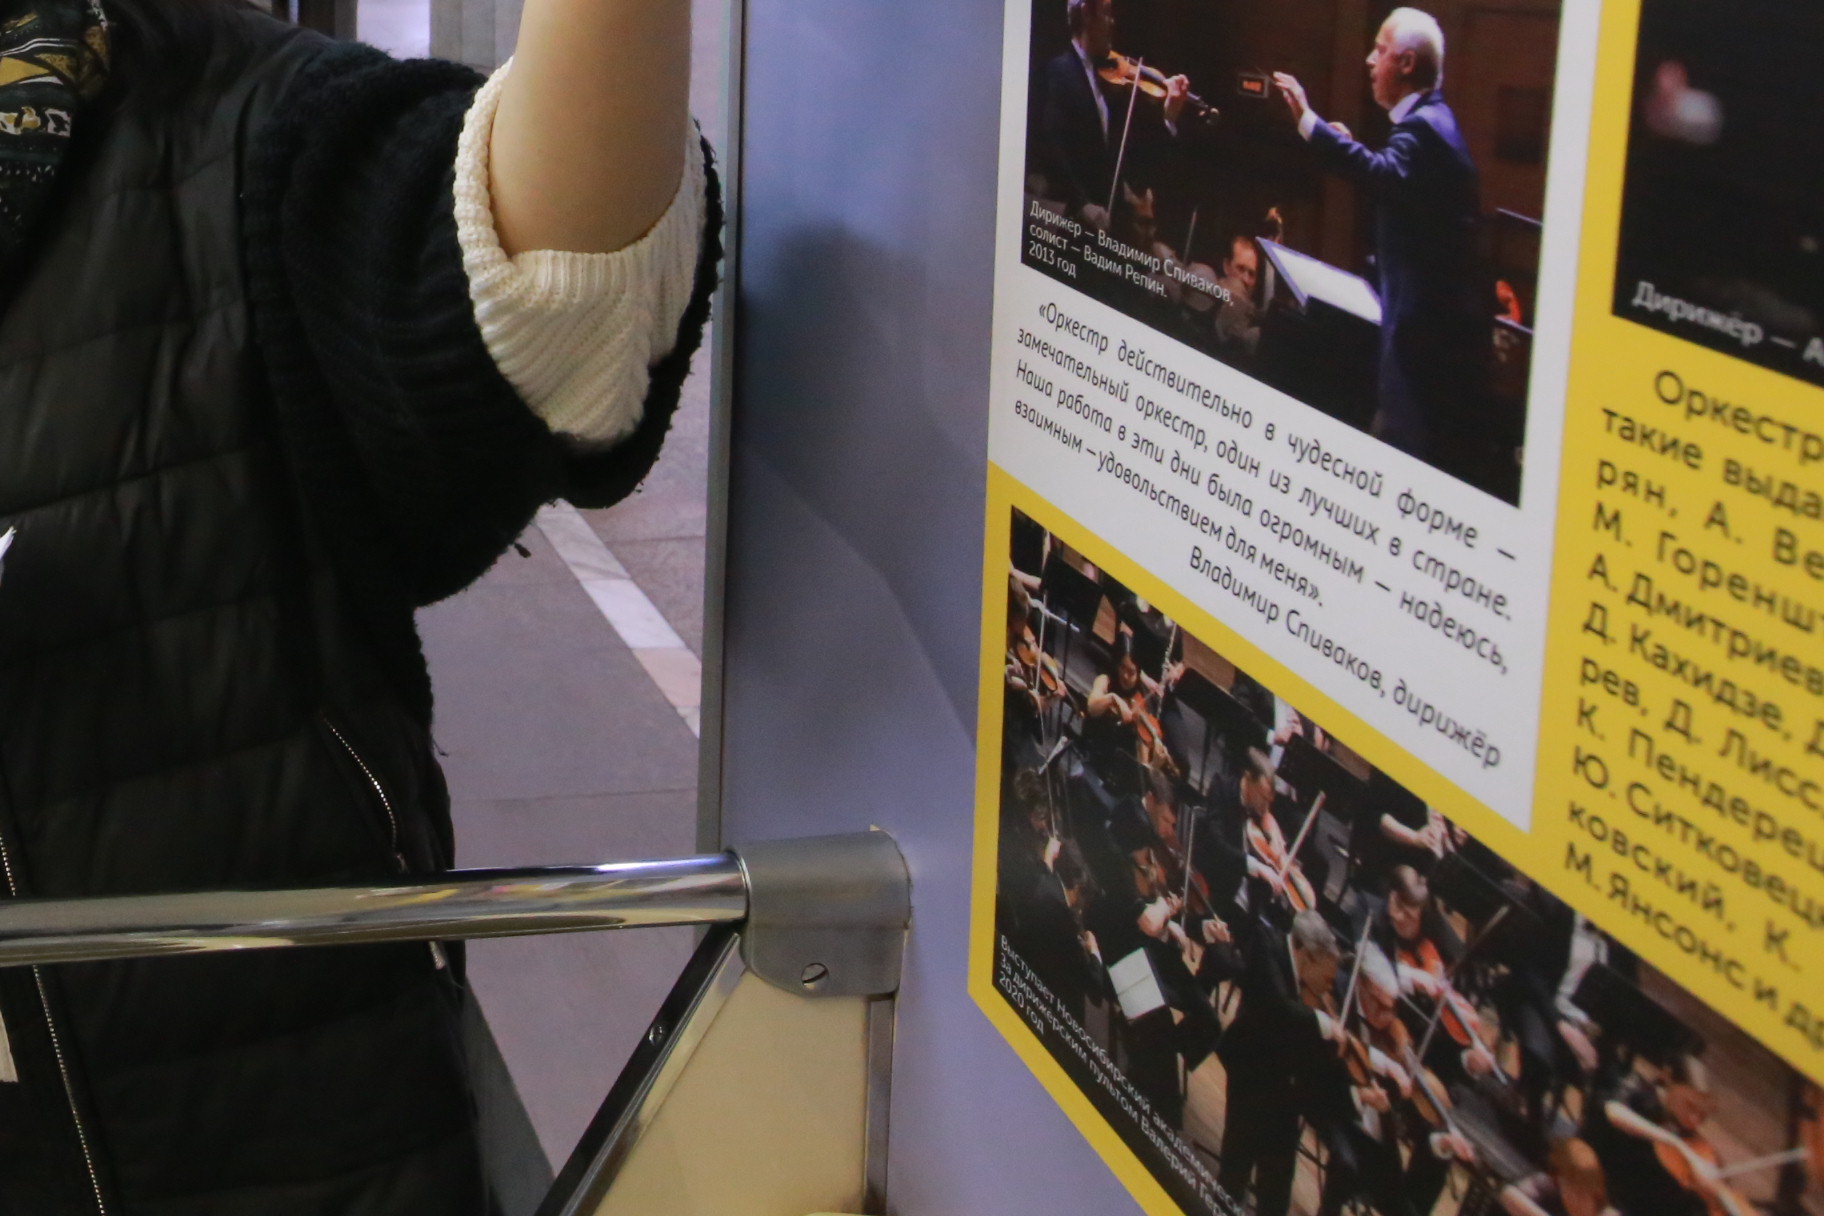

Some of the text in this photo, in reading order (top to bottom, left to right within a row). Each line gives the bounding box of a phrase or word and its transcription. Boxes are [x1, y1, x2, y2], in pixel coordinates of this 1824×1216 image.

[1028, 240, 1077, 279] 2013 год
[1029, 224, 1069, 252] солист
[1083, 243, 1123, 275] Вадим
[1125, 265, 1168, 299] Репин.
[1097, 229, 1161, 274] Владимир
[1163, 256, 1235, 307] Спиваков,
[1631, 280, 1764, 348] Дирижёр
[1038, 302, 1109, 356] «Оркестр
[1117, 338, 1253, 430] действительно
[1264, 422, 1276, 441] в
[1288, 432, 1384, 500] чудесной
[1397, 487, 1479, 549] форме
[1601, 407, 1704, 471] такие
[1014, 399, 1083, 454] взаимным
[1097, 450, 1223, 544] удовольствием
[1225, 524, 1258, 565] для
[1259, 550, 1324, 608] меня».
[1017, 328, 1513, 623] замечательный оркестр, один из лучших в стране.
[1596, 458, 1678, 518] рян,
[1703, 500, 1743, 544] А.
[1015, 358, 1054, 398] Наша
[1056, 387, 1113, 435] работа
[1117, 424, 1128, 442] в
[1130, 431, 1165, 465] эти
[1169, 449, 1202, 487] дни
[1207, 472, 1253, 518] была
[1259, 509, 1366, 584] огромным
[1398, 590, 1509, 676] надеюсь,
[1592, 500, 1633, 547] М.
[1587, 553, 1619, 594] А.
[1189, 544, 1502, 770] Владимир Спиваков, дирижёр
[1581, 601, 1618, 646] Д.
[1576, 696, 1606, 742] К.
[1662, 698, 1703, 744] Д.
[1573, 744, 1617, 800] Ю.
[1565, 840, 1601, 893] М.
[1607, 870, 1745, 991] Янсонс
[1753, 976, 1780, 1013] и
[1763, 916, 1801, 973] К.
[999, 970, 1045, 1036] 2020 год
[1000, 934, 1056, 1005] Выступает
[1056, 997, 1151, 1115] Новосибирский
[1000, 952, 1013, 976] За
[1012, 971, 1088, 1064] дирижёрским
[1088, 1060, 1139, 1124] пультом
[1140, 1114, 1197, 1191] Валерий
